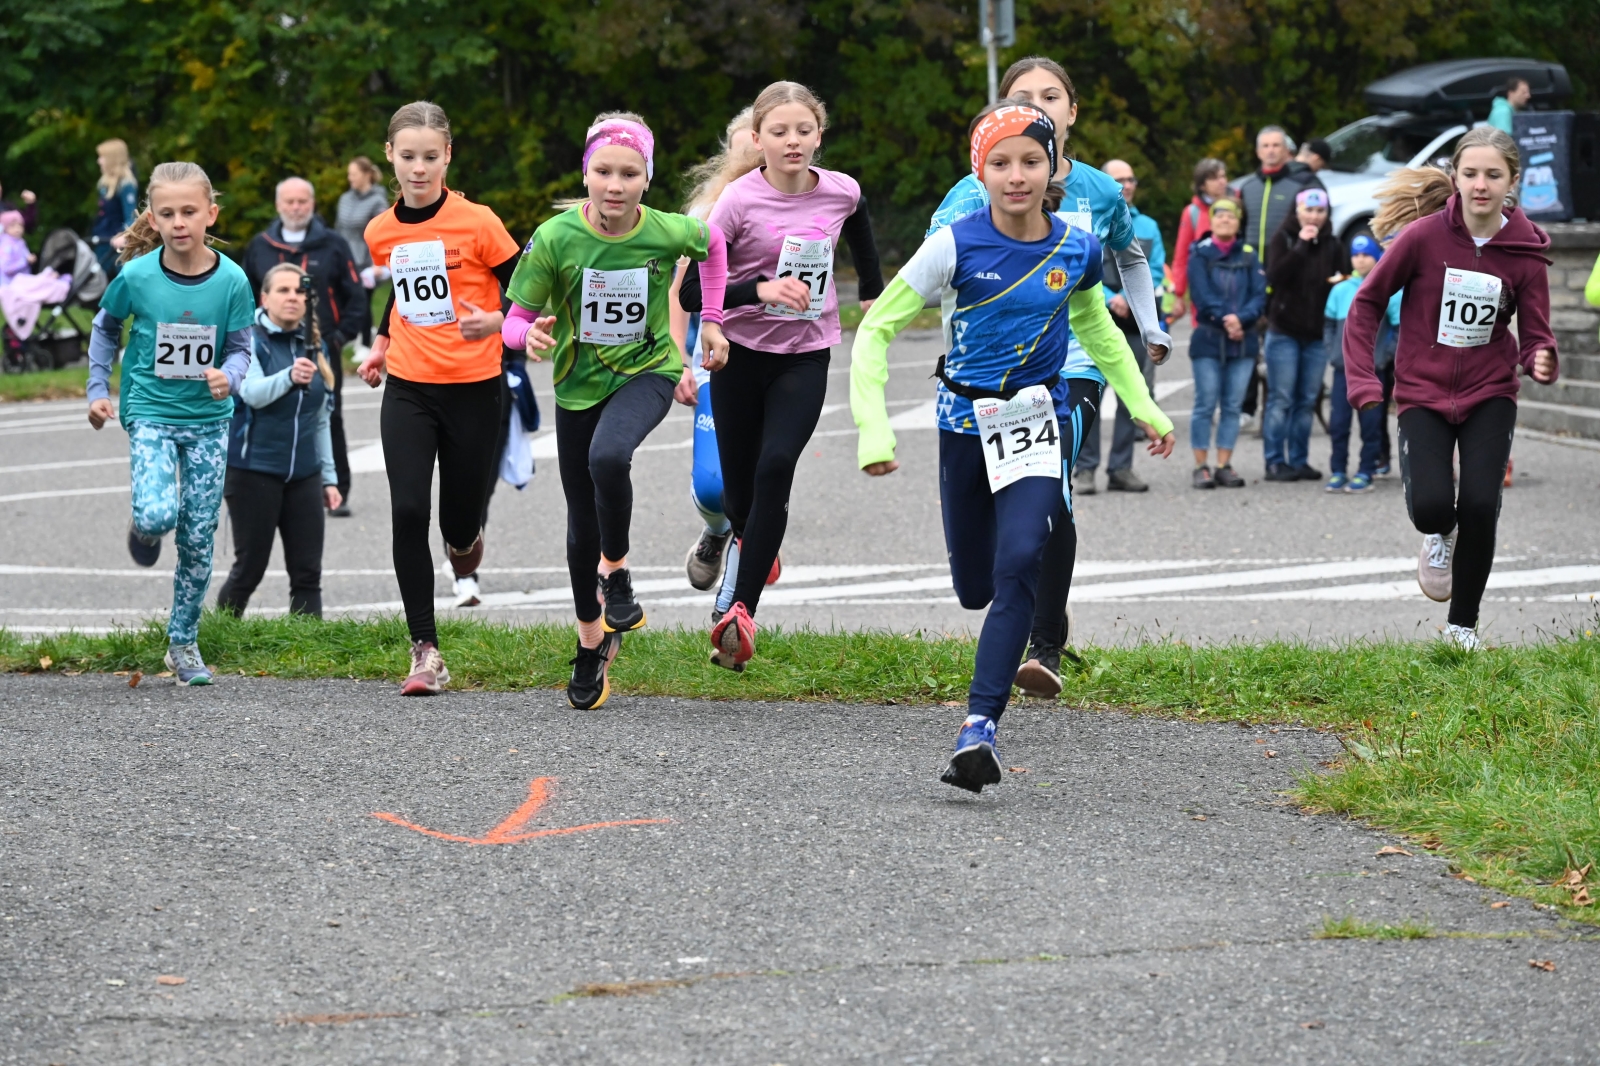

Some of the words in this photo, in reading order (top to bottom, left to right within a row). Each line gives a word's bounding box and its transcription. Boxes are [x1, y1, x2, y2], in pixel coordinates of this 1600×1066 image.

[1010, 117, 1048, 129] EXPERT
[785, 244, 801, 253] CUP
[420, 264, 441, 272] METUJE
[810, 261, 829, 269] METUJE
[974, 271, 1002, 281] ALEA
[396, 274, 449, 303] 160
[1457, 292, 1473, 300] CENA
[1473, 295, 1494, 303] METUJE
[584, 300, 646, 325] 159
[1444, 299, 1496, 326] 102
[156, 342, 214, 366] 210
[978, 407, 999, 417] CUP
[999, 419, 1020, 428] CENA
[1021, 410, 1049, 423] METUJE
[986, 418, 1059, 461] 134
[995, 457, 1020, 470] MONIKA
